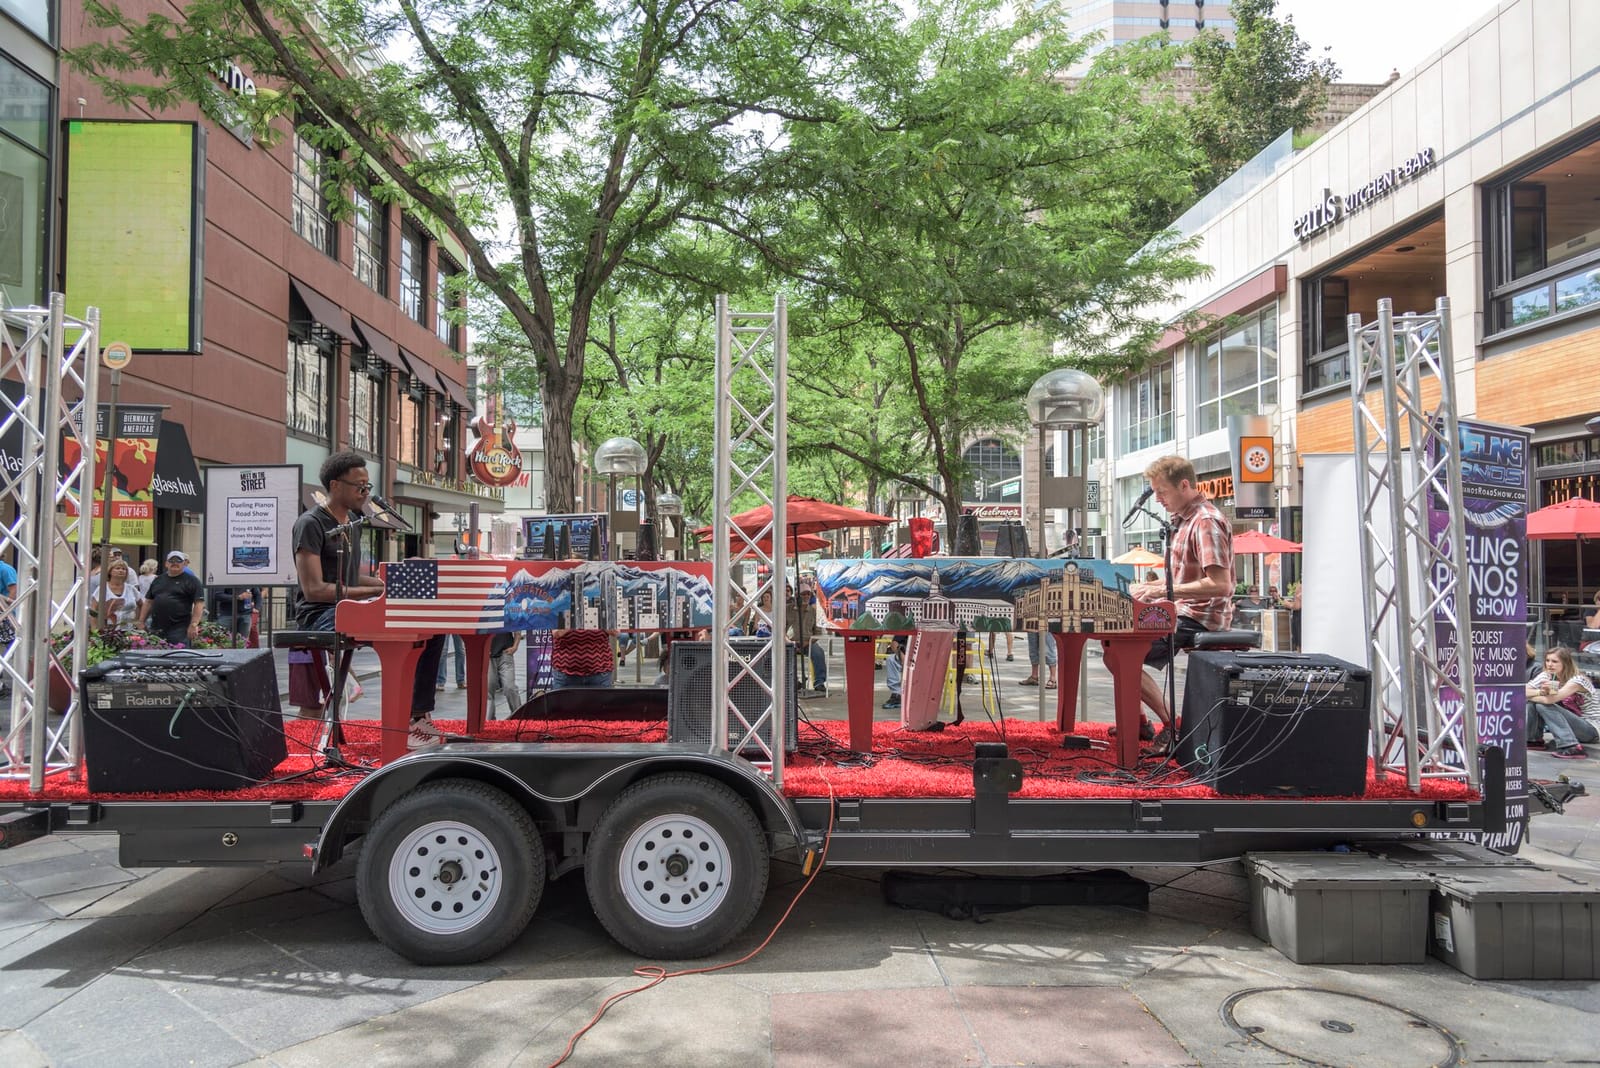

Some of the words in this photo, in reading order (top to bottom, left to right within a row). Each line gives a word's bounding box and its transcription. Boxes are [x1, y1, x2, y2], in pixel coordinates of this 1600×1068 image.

[1292, 188, 1341, 241] earls
[1343, 170, 1394, 214] KITCHEN
[1404, 148, 1433, 177] BAR
[123, 424, 154, 433] AMERICAS
[474, 451, 498, 463] Hard
[499, 454, 521, 468] Rock
[177, 477, 197, 496] hut
[241, 478, 266, 491] STREET
[1195, 475, 1235, 499] PROTE
[118, 507, 132, 517] JULY
[133, 507, 148, 517] 14-19
[121, 528, 144, 536] CULTURE
[1437, 532, 1520, 566] DELING
[1436, 562, 1518, 597] PINOS
[1476, 597, 1518, 617] SHOW
[1448, 630, 1458, 644] AL
[1471, 631, 1503, 645] EQUEST
[1489, 647, 1517, 661] MUSIC
[1484, 663, 1514, 677] SHOW
[125, 695, 171, 706] Roland
[1264, 693, 1309, 704] Roland
[1475, 691, 1513, 712] ENUE
[1477, 714, 1513, 737] USIC
[1505, 766, 1522, 777] ARTIES
